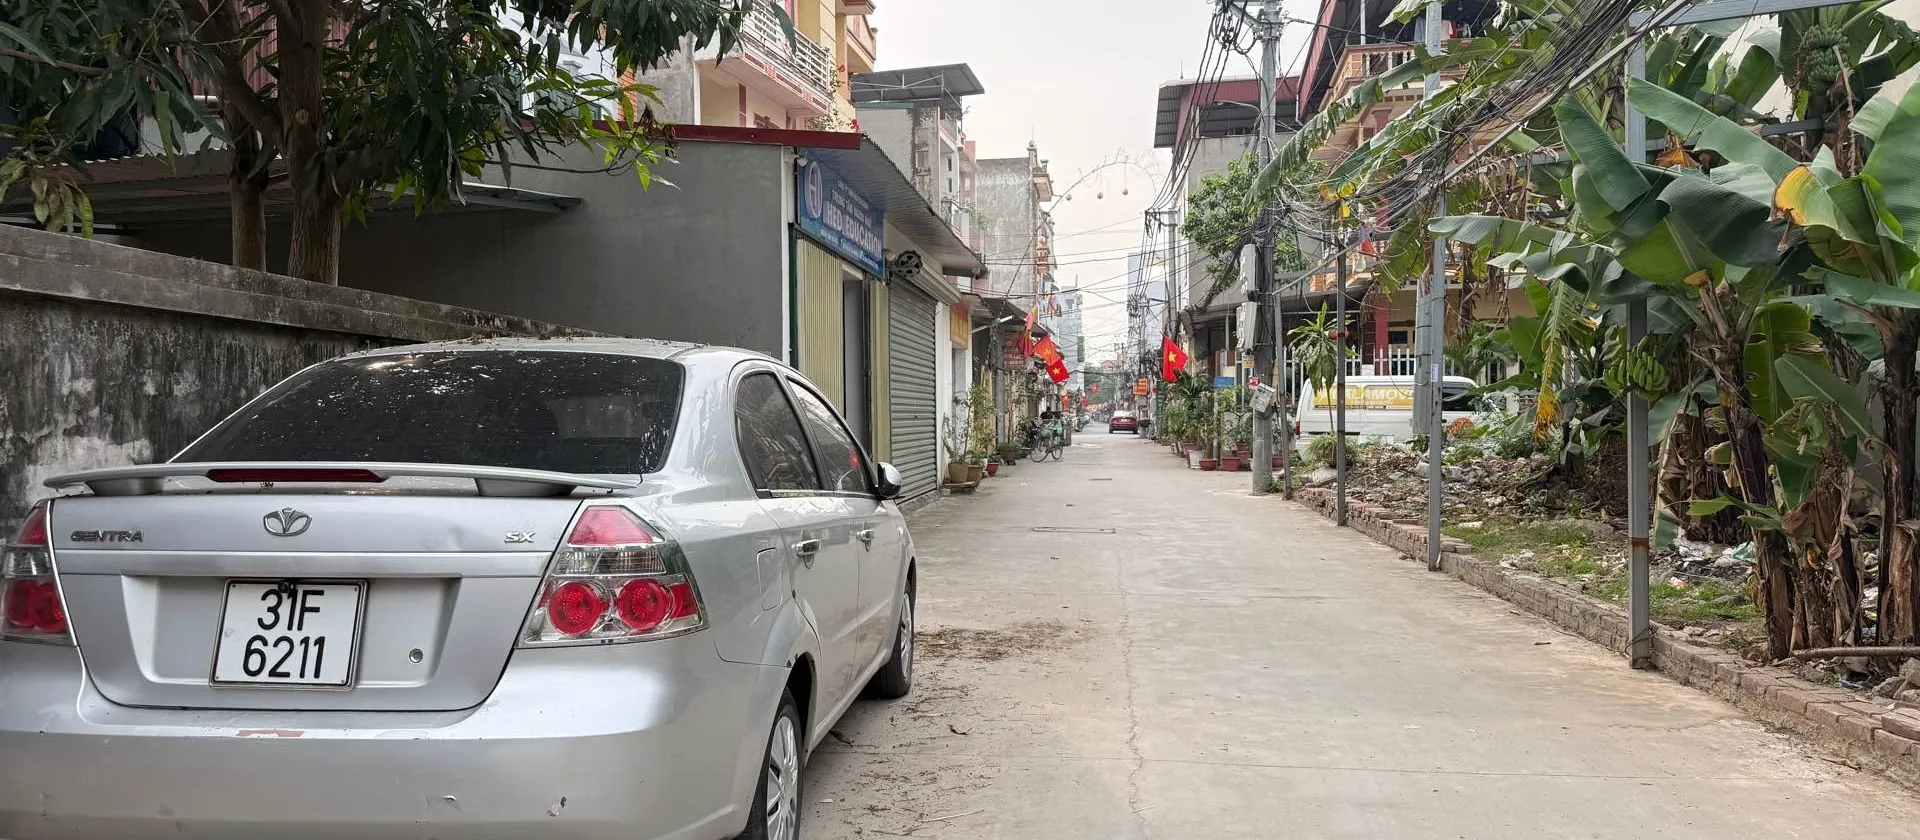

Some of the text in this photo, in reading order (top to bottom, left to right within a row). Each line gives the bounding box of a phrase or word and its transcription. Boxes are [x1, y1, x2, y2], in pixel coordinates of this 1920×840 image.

[845, 215, 882, 258] EDUCATION
[70, 530, 143, 542] GENTRA
[504, 532, 536, 543] SX
[257, 589, 325, 631] 31F
[243, 635, 326, 679] 6211
